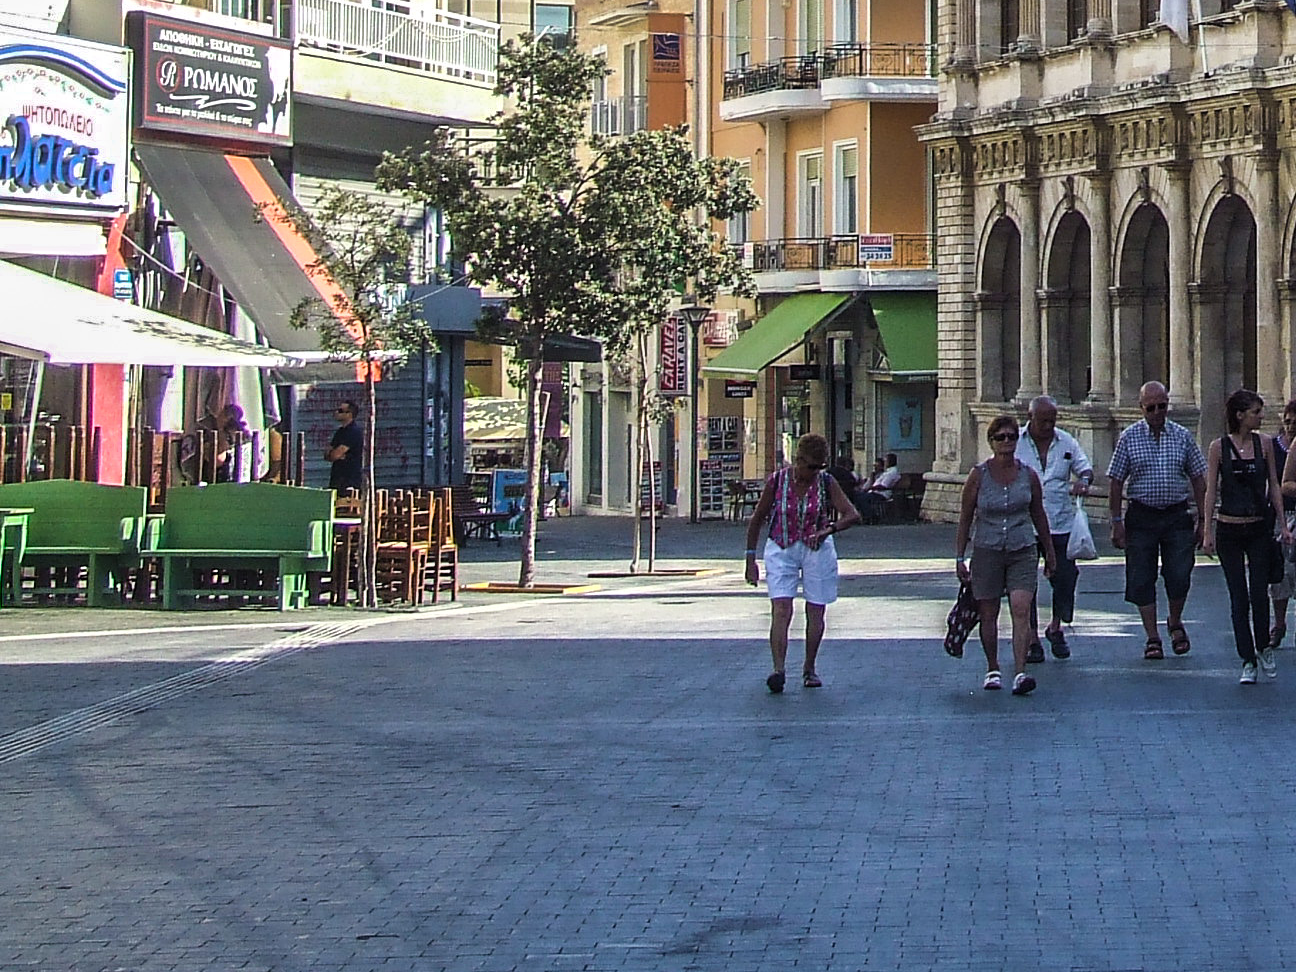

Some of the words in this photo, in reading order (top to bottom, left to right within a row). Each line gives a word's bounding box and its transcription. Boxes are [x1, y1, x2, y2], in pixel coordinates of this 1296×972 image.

[159, 29, 204, 48] ΑΠΟΘΗΚΗ
[184, 66, 258, 98] ΡΩΜΑΝΟΣ
[22, 104, 93, 137] ΨΗΤΟΠΩΛΕΙΟ
[677, 358, 685, 390] RENT
